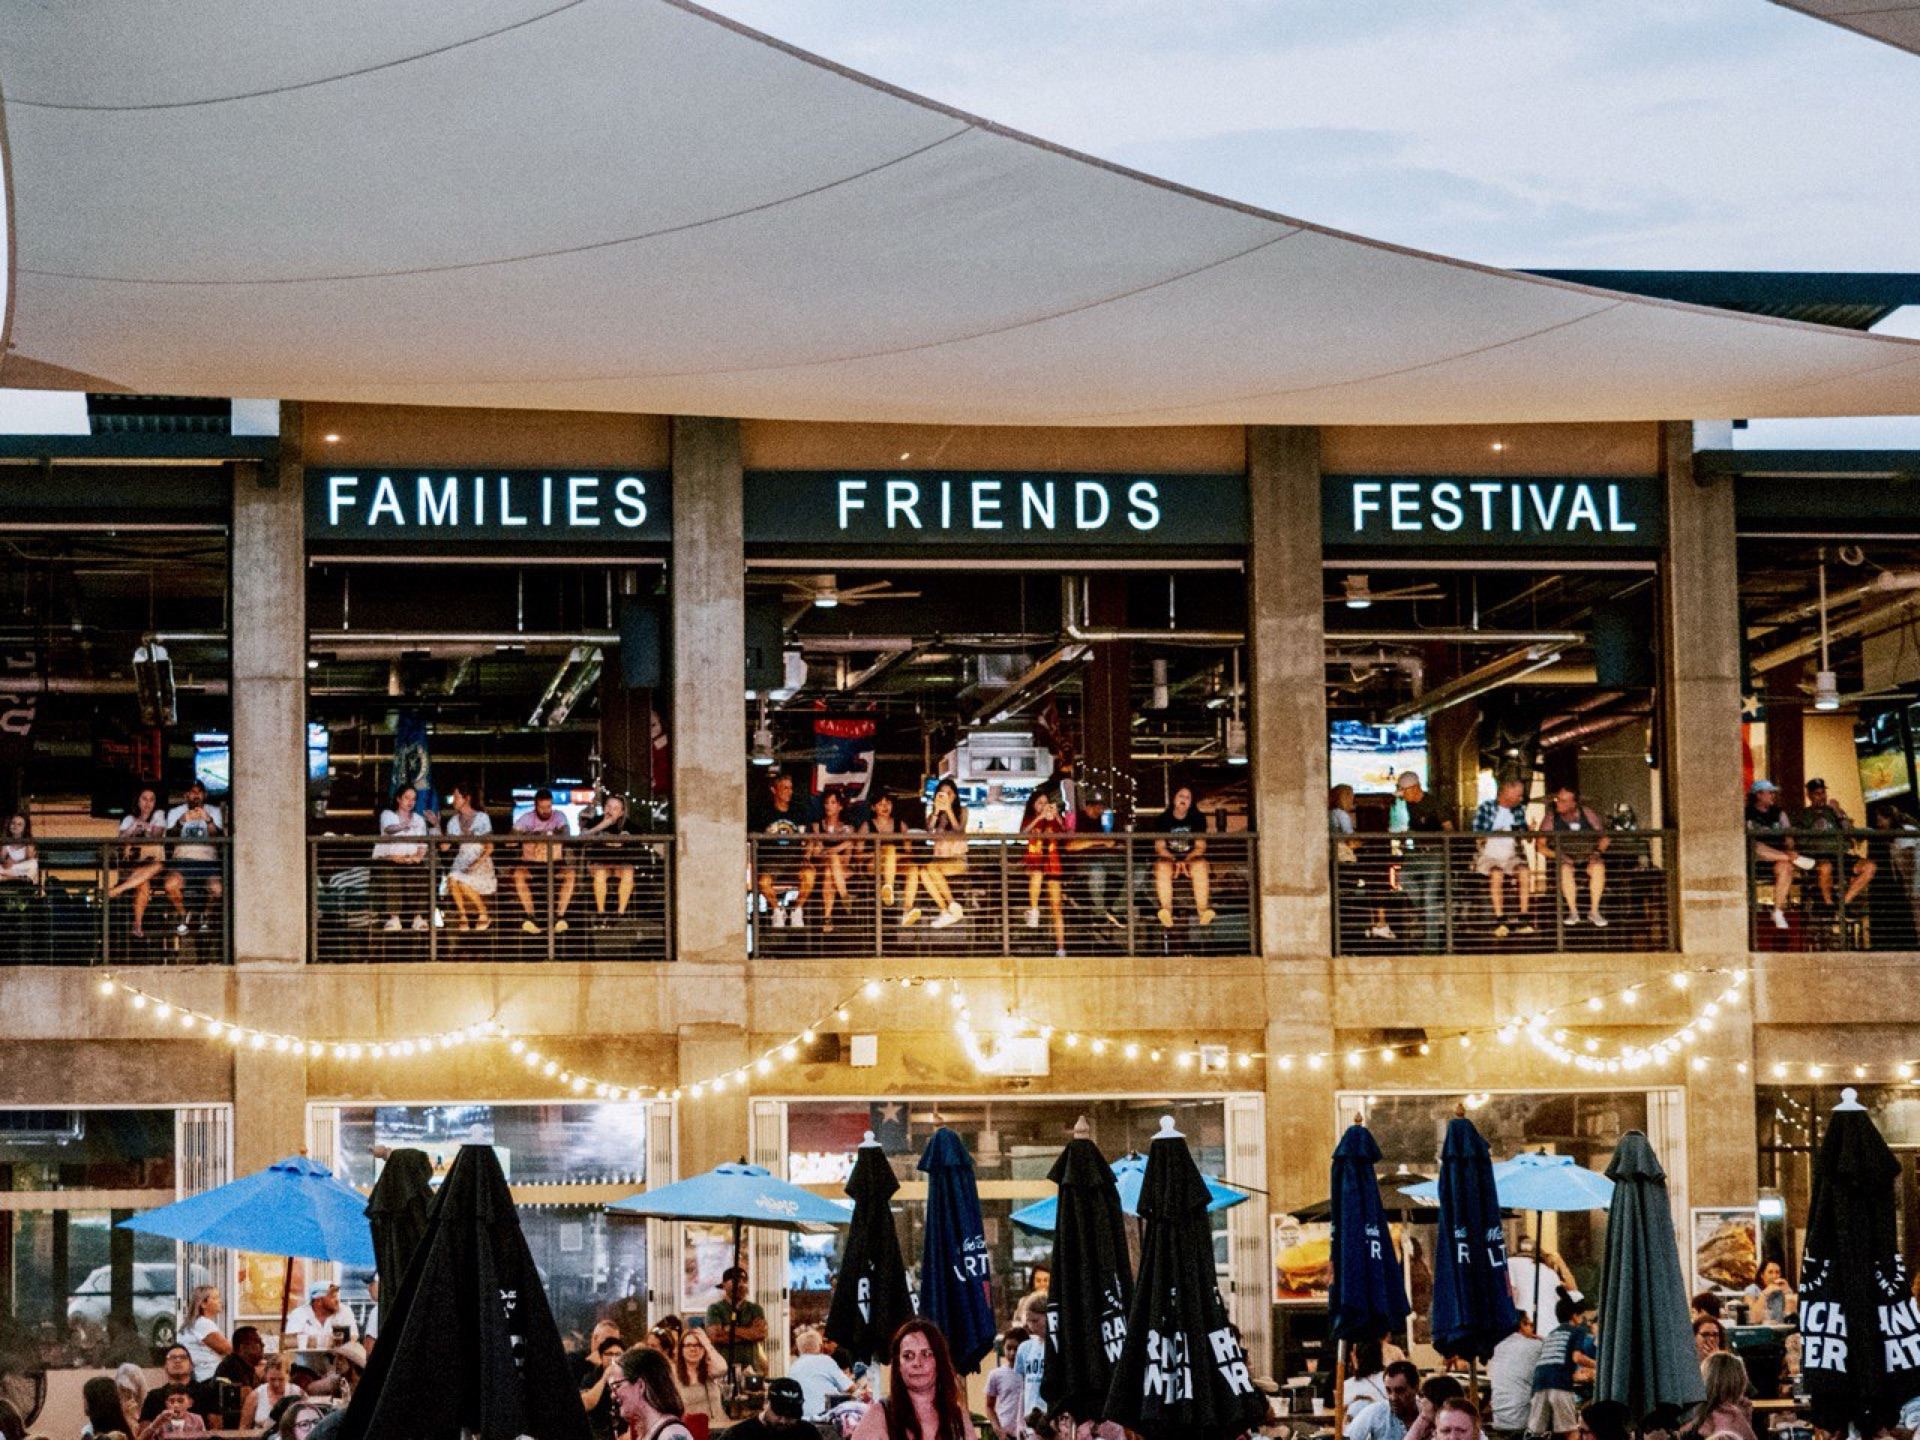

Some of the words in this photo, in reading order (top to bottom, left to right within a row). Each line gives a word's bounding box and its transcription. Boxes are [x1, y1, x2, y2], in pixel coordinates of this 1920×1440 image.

[329, 476, 647, 527] FAMILIES
[838, 480, 1160, 530] FRIENDS
[1353, 483, 1636, 532] FESTIVAL
